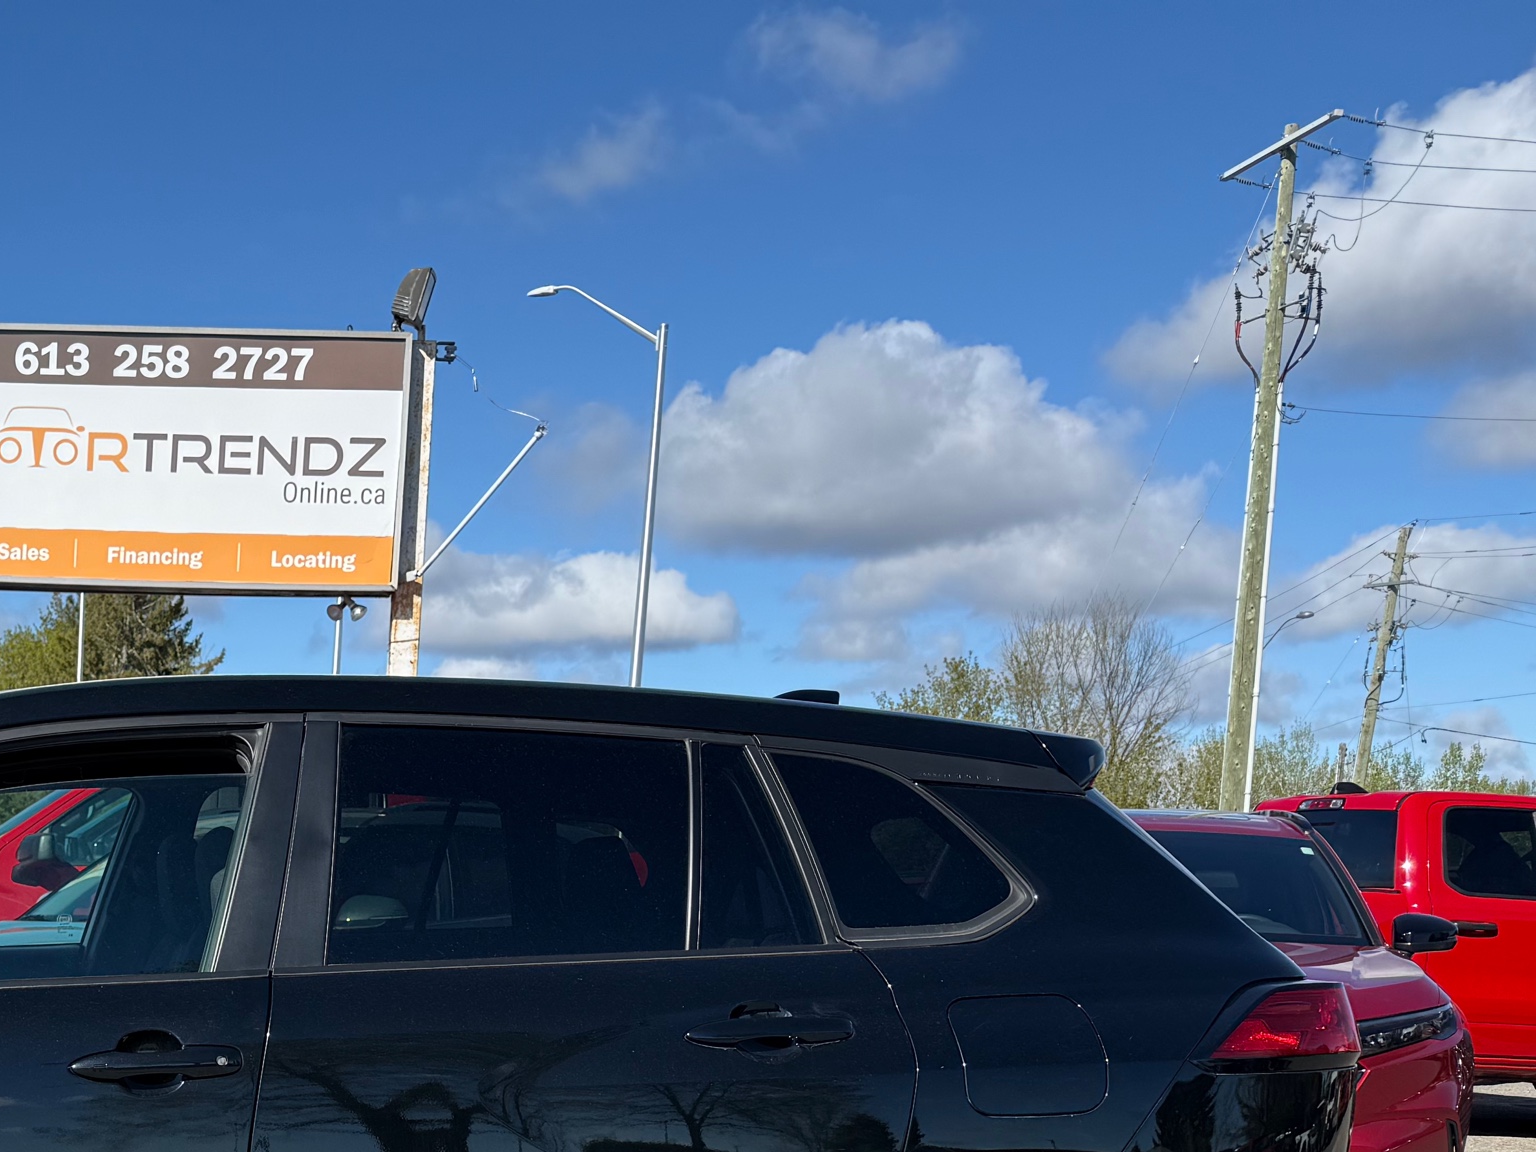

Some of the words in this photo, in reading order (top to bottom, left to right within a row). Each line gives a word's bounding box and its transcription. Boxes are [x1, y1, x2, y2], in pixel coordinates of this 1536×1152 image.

[15, 341, 90, 376] 613
[112, 343, 190, 379] 258
[212, 346, 314, 381] 2727
[283, 481, 385, 505] Online.ca
[107, 546, 203, 569] Financing
[270, 550, 356, 572] Locating
